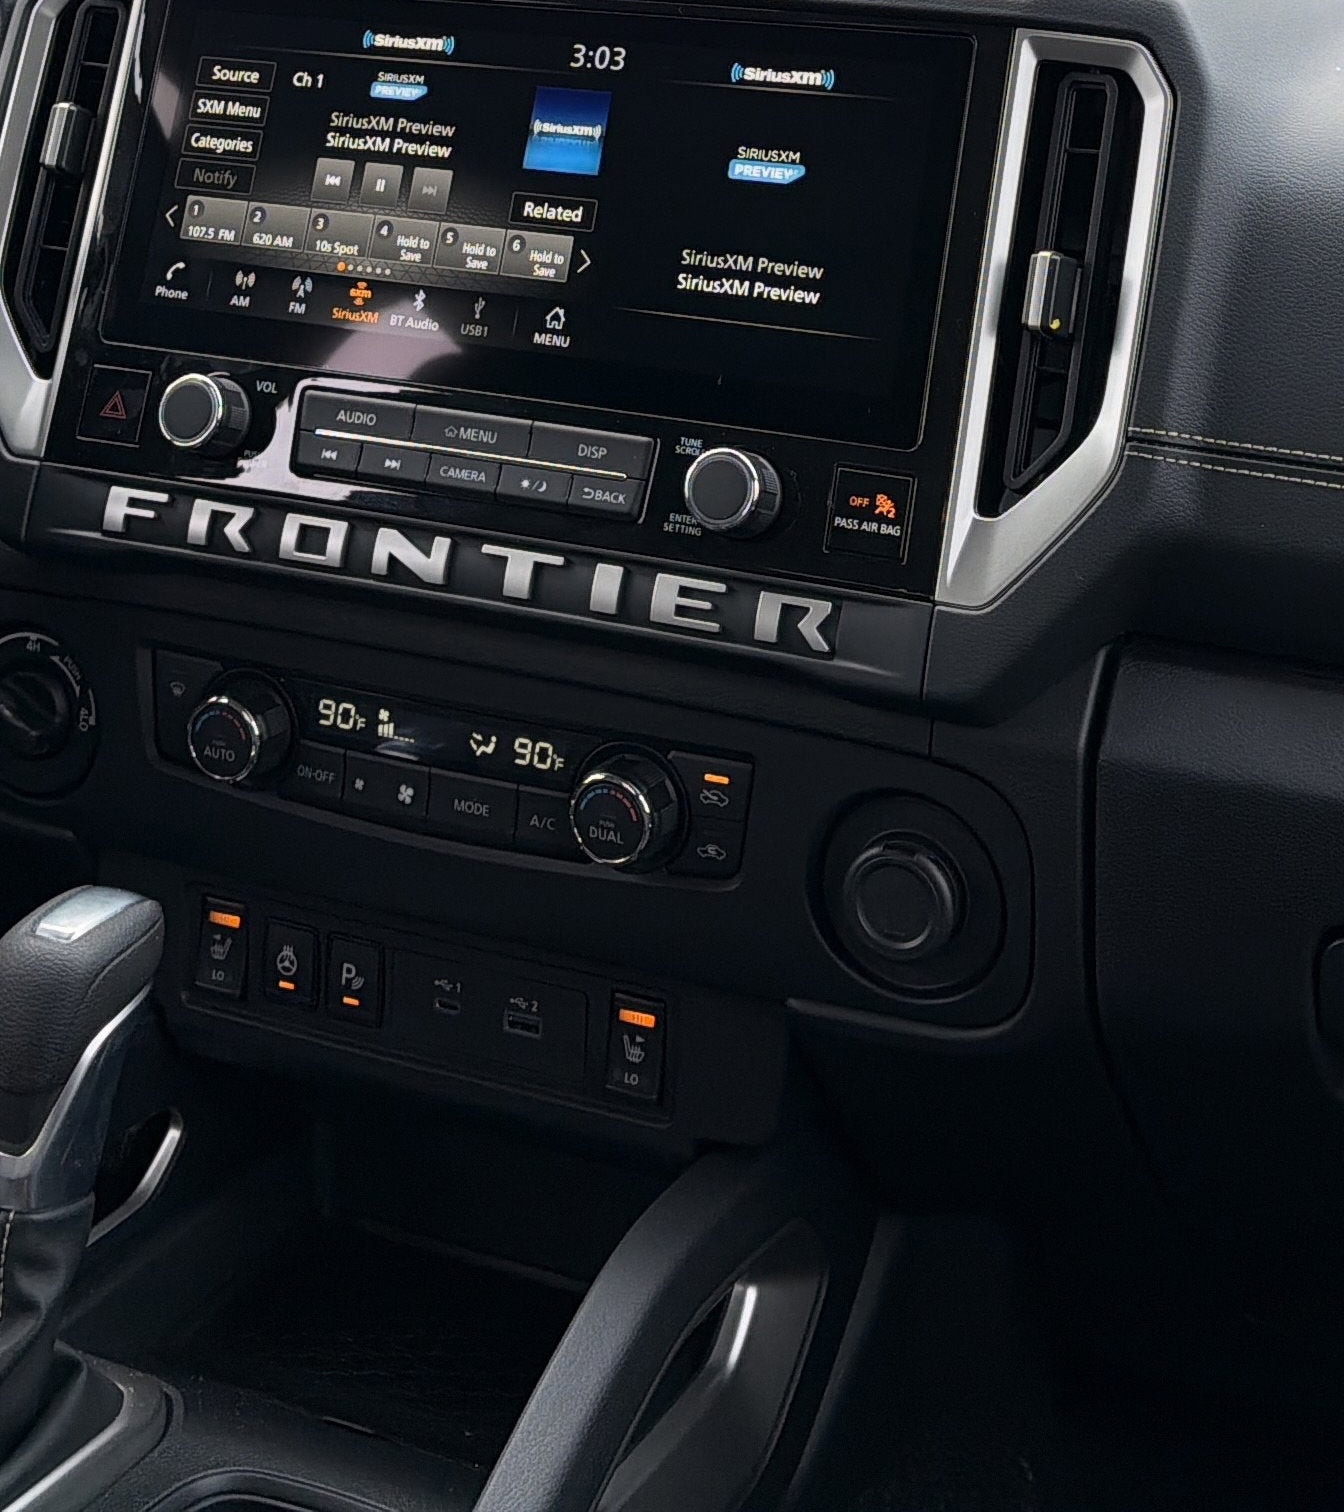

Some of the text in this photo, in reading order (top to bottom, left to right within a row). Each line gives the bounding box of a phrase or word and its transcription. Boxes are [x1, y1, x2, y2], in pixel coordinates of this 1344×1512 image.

[570, 44, 627, 71] 3:03
[212, 65, 260, 84] Source
[292, 72, 325, 89] Ch 1
[377, 71, 425, 84] SIRIUSXM
[197, 98, 261, 118] SXM Menu
[329, 111, 456, 138] SiriusXM Preview
[190, 132, 254, 154] Categories
[325, 131, 453, 159] SiriusXM Preview
[737, 146, 801, 164] SIRIUSXM
[193, 167, 238, 190] Notify
[523, 201, 584, 223] Related
[187, 225, 236, 241] 107.5 FM
[252, 232, 294, 248] 620 AM
[315, 239, 359, 257] 10s Spot
[396, 235, 418, 249] Hold
[462, 242, 484, 256] Hold
[399, 249, 422, 263] Save
[465, 257, 489, 270] Save
[529, 249, 565, 265] Hold to
[680, 249, 825, 280] SiriusXM Preview
[532, 264, 556, 278] Save
[155, 285, 189, 301] Phone
[676, 273, 821, 305] SiriusXM Preview
[229, 295, 251, 308] AM
[288, 302, 306, 315] FM
[331, 307, 379, 324] SiriusXM
[389, 314, 440, 332] BT Audio
[460, 323, 490, 338] USB1
[533, 332, 571, 348] MENU
[255, 379, 278, 395] VOL
[336, 408, 377, 427] AUDIO
[458, 426, 498, 444] MENU
[680, 436, 704, 448] TUNE
[577, 443, 608, 460] DISP
[439, 465, 487, 483] CAMERA
[594, 490, 626, 505] BACK
[849, 495, 870, 508] OFF
[663, 522, 702, 537] SETTING
[834, 517, 901, 537] PASS AIR BAG
[102, 486, 835, 652] FRONTIER
[26, 640, 41, 653] 4H
[203, 745, 236, 763] AUTO
[453, 798, 490, 818] MODE
[529, 814, 556, 831] A/C
[589, 825, 625, 845] DUAL
[212, 968, 225, 981] LO
[624, 1071, 640, 1086] LO
